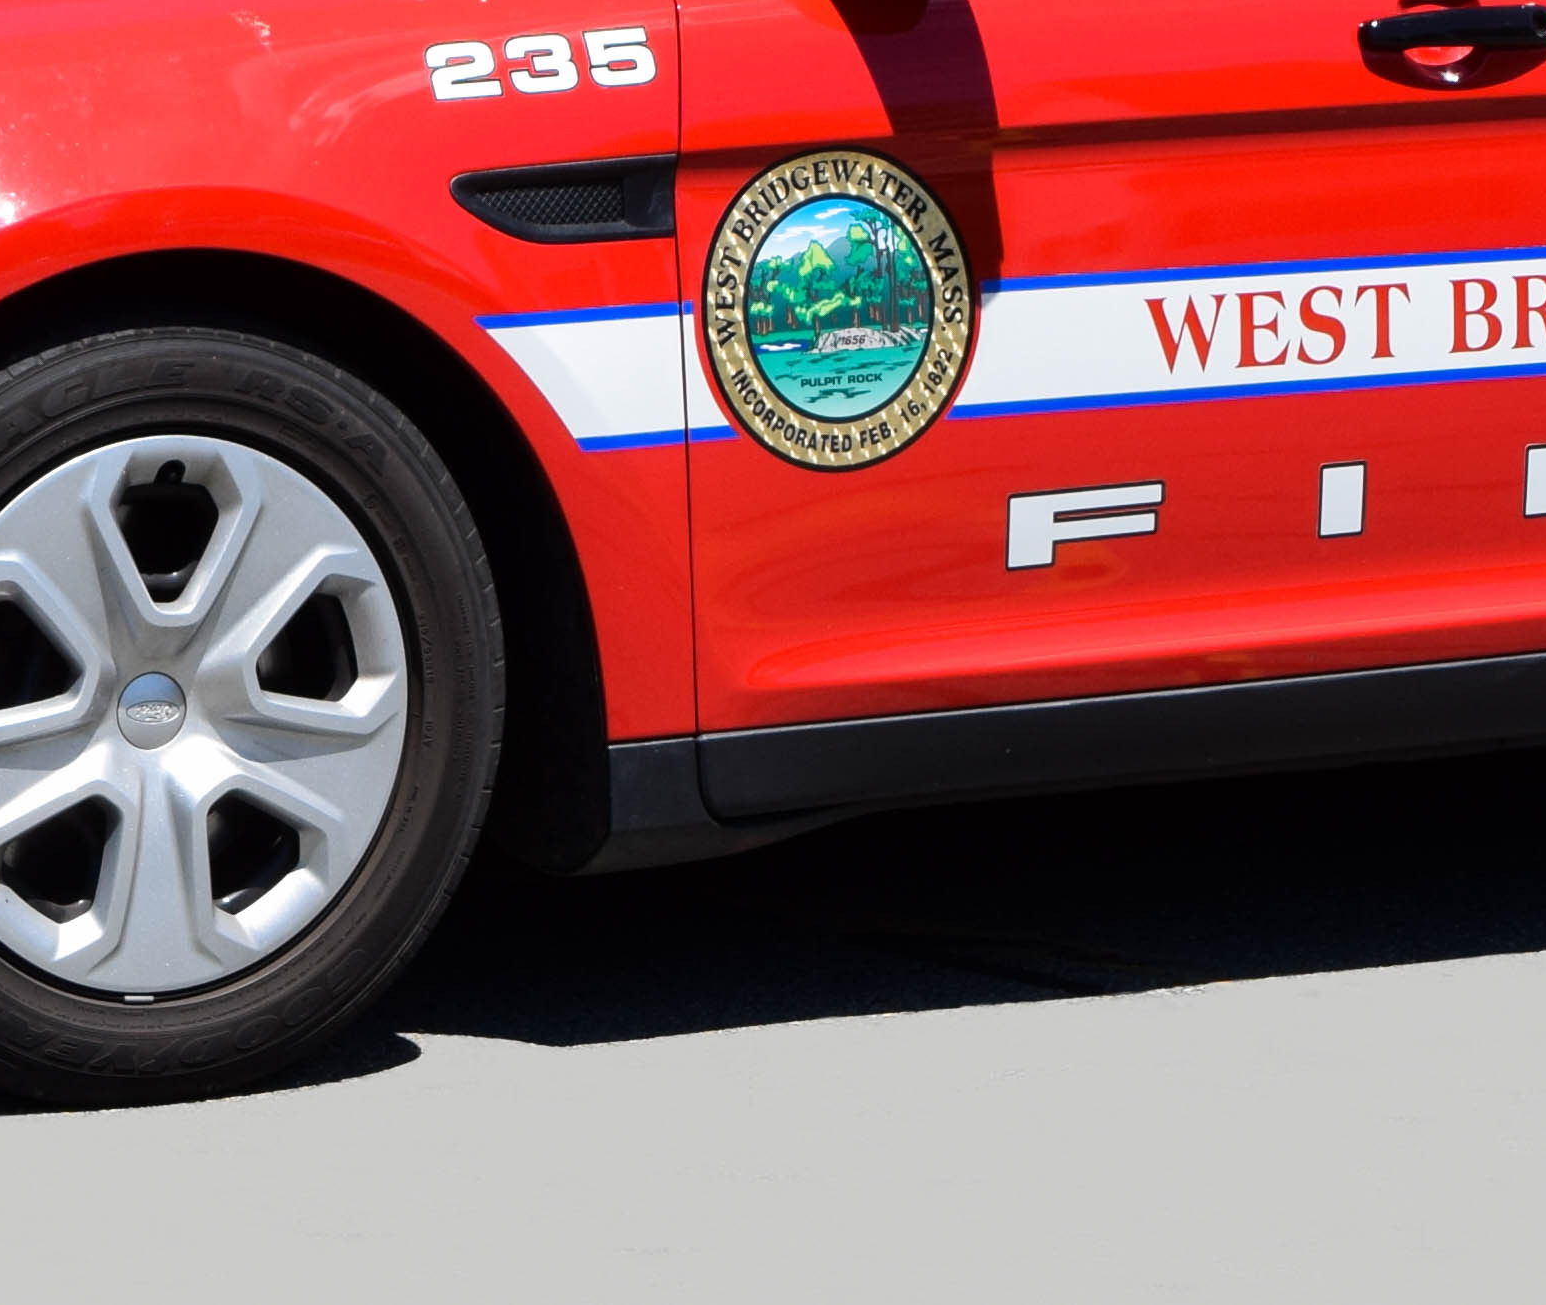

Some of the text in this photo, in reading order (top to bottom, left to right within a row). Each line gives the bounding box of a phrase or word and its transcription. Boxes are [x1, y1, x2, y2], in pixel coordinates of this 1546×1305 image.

[424, 25, 657, 101] 235
[716, 247, 741, 347] WEST
[732, 159, 930, 244] BRIDGEWATER,
[1144, 282, 1410, 374] WEST
[731, 350, 954, 452] INCORPORATED FEB. 16, 1822
[800, 373, 883, 389] PULPIT ROCK
